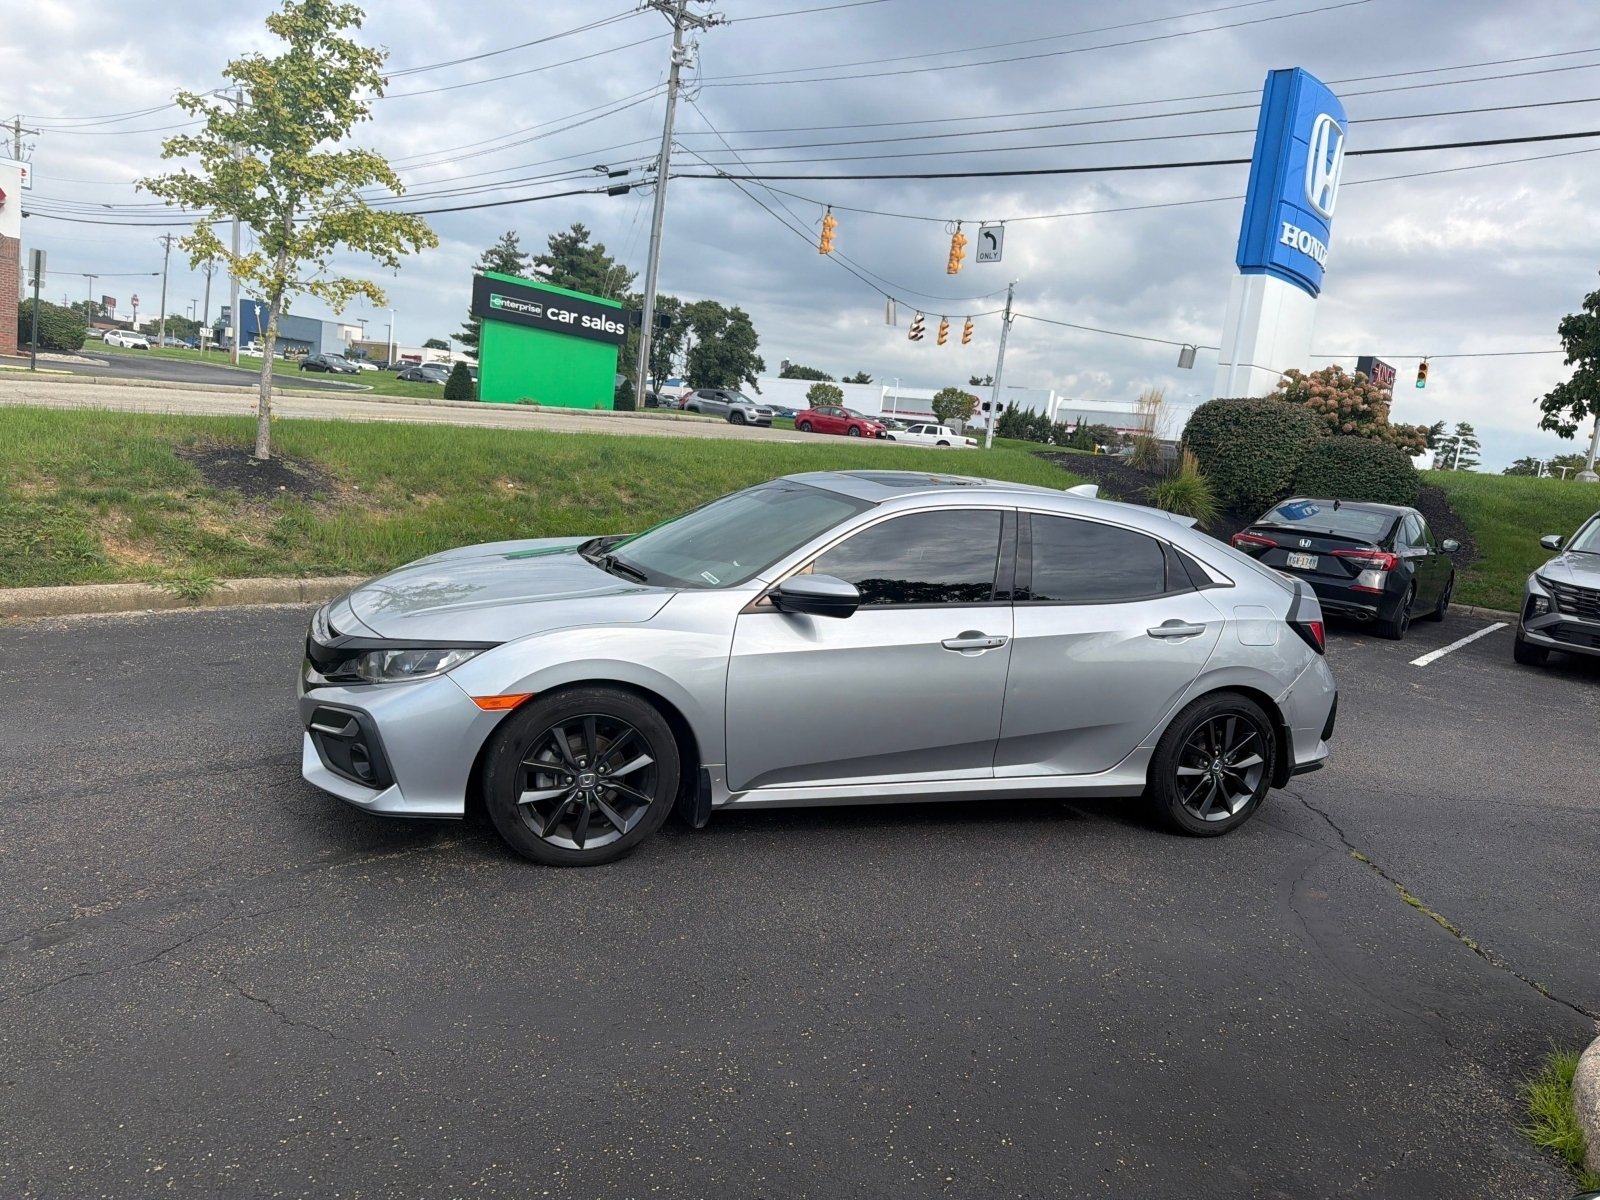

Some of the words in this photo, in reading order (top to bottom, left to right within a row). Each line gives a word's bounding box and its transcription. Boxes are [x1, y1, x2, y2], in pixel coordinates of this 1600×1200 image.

[980, 252, 998, 260] ONLY
[494, 298, 541, 314] enterprise
[546, 307, 579, 325] car
[581, 314, 625, 335] sales
